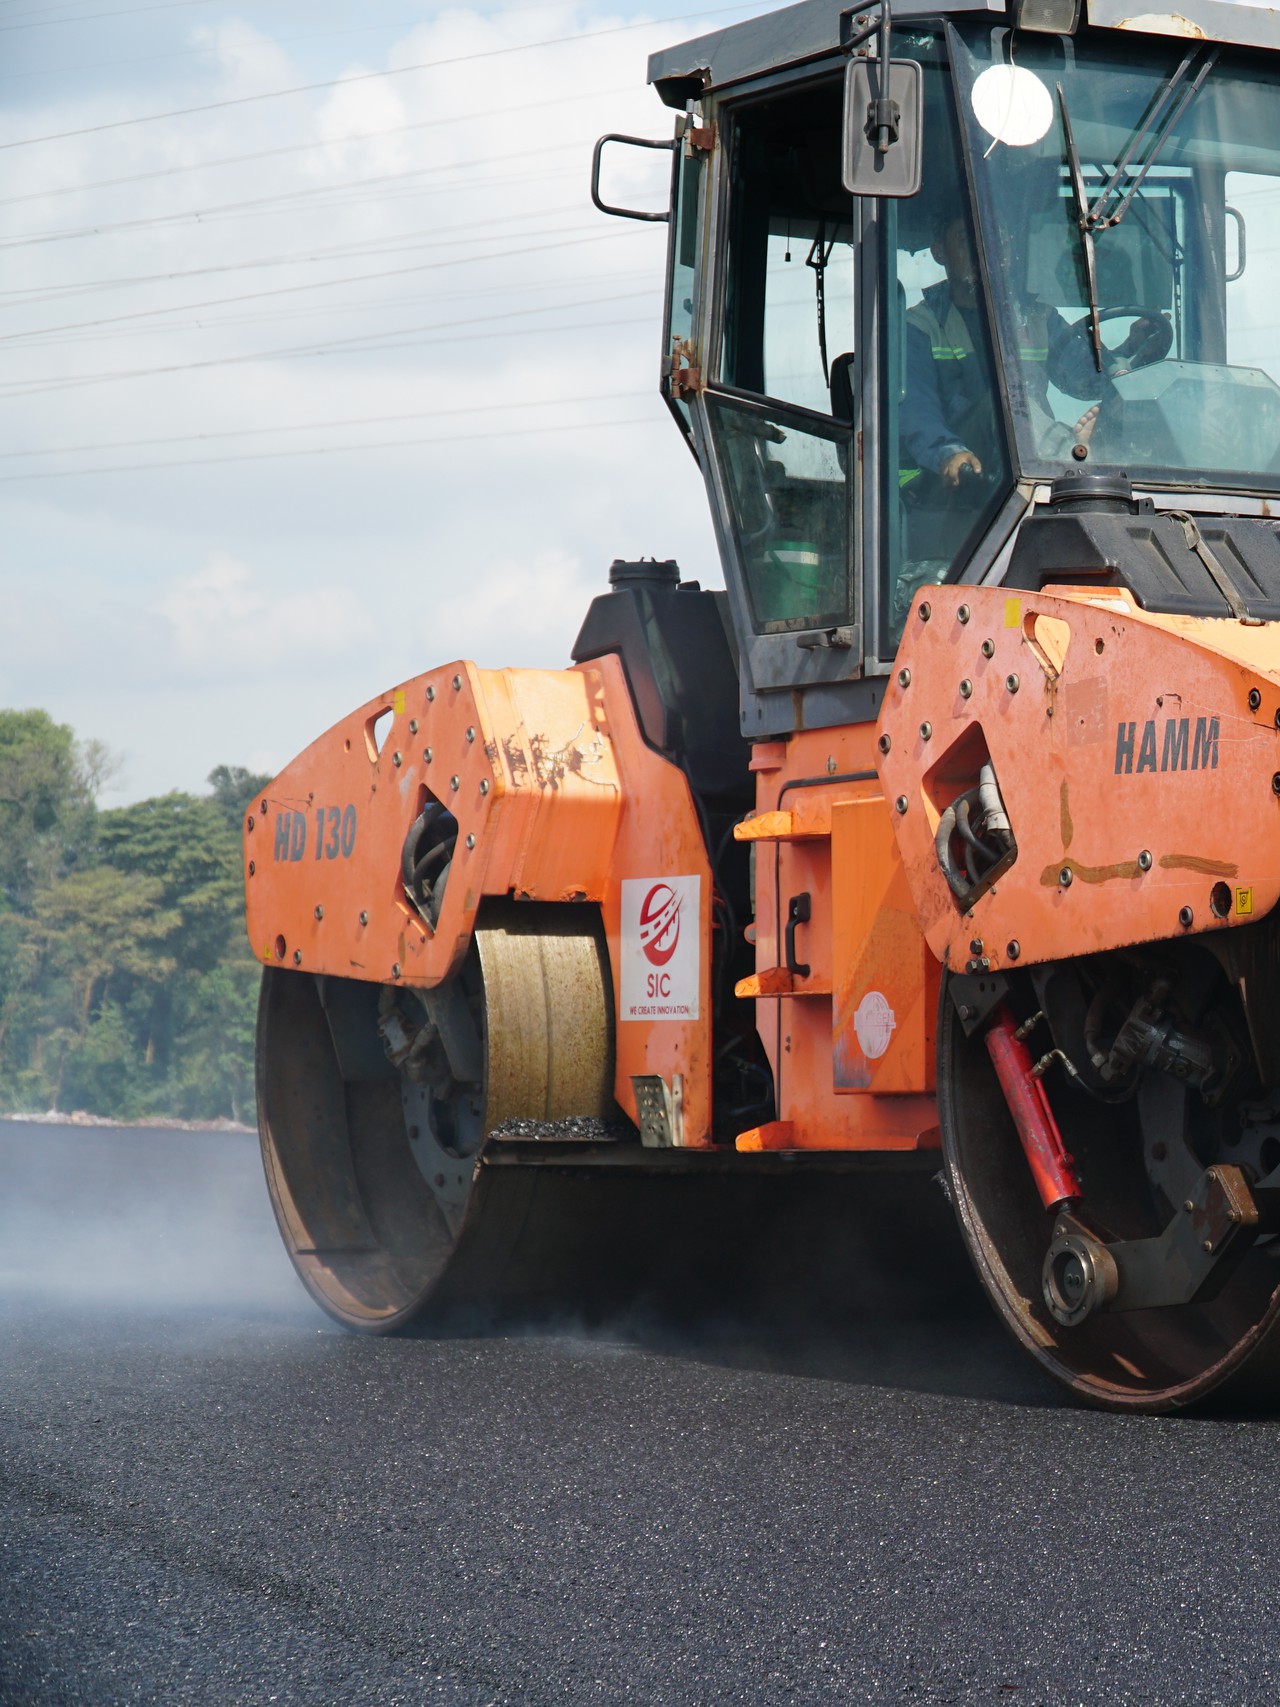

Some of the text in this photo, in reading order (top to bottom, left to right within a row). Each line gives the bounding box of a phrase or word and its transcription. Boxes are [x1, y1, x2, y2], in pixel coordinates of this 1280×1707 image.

[1114, 716, 1220, 775] HAMM
[274, 803, 357, 862] HD 130
[646, 973, 671, 998] SIC
[629, 1005, 689, 1015] WE CREATE INNOVATION
